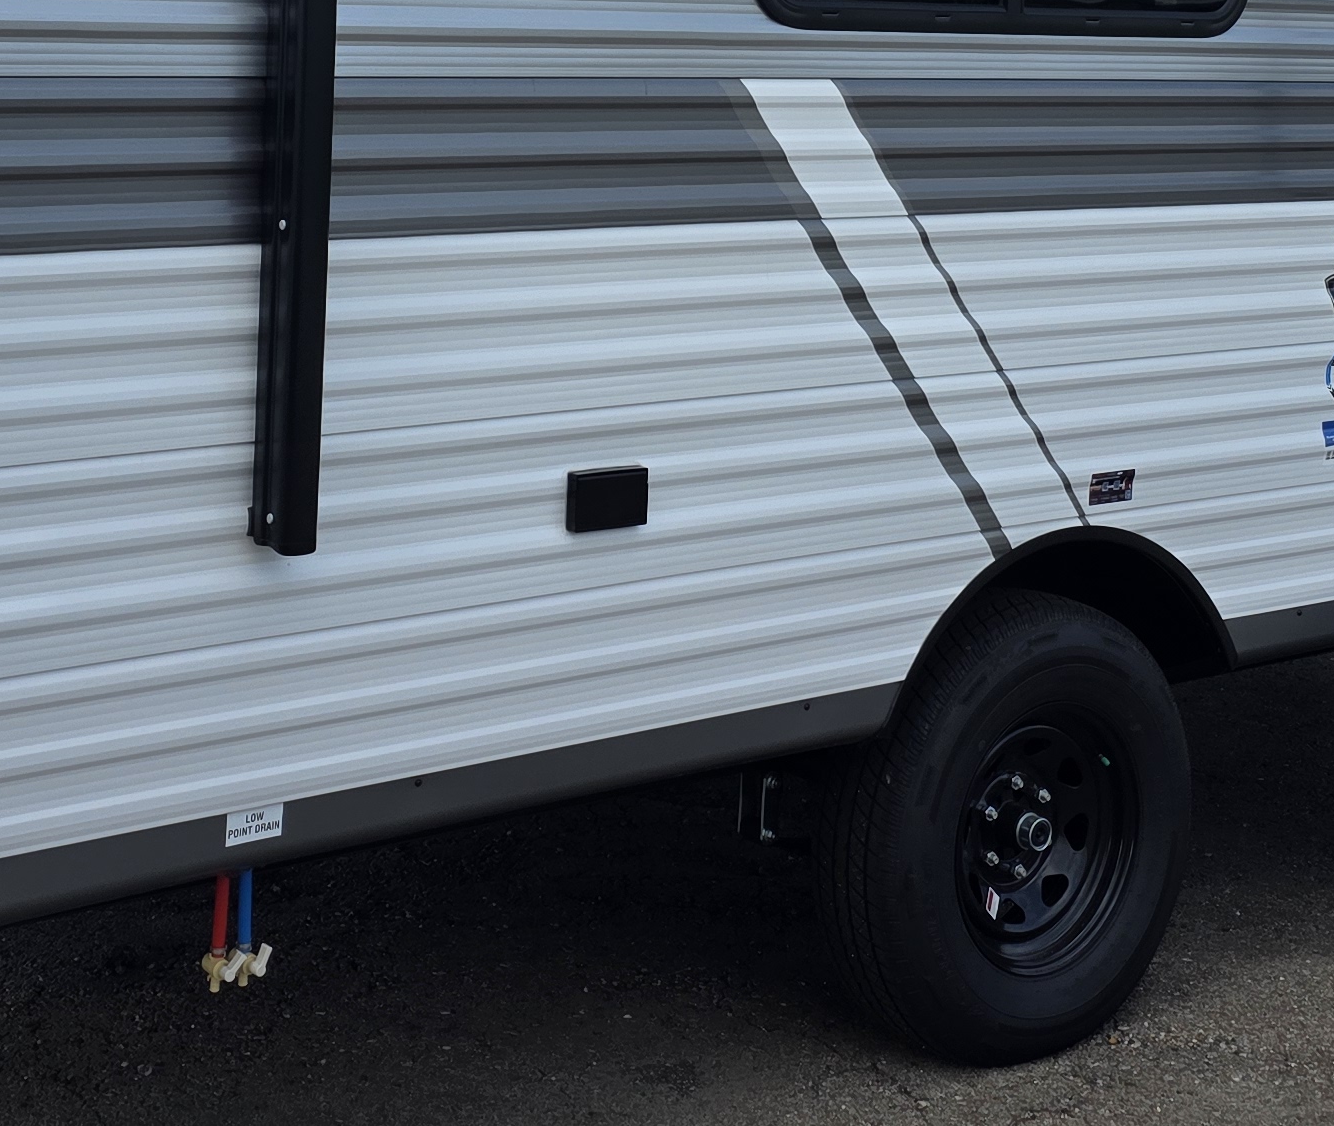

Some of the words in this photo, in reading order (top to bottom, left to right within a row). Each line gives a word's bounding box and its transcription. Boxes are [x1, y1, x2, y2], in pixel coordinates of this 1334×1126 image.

[246, 811, 264, 823] LOW
[228, 826, 252, 839] POINT
[255, 820, 279, 833] DRAIN
